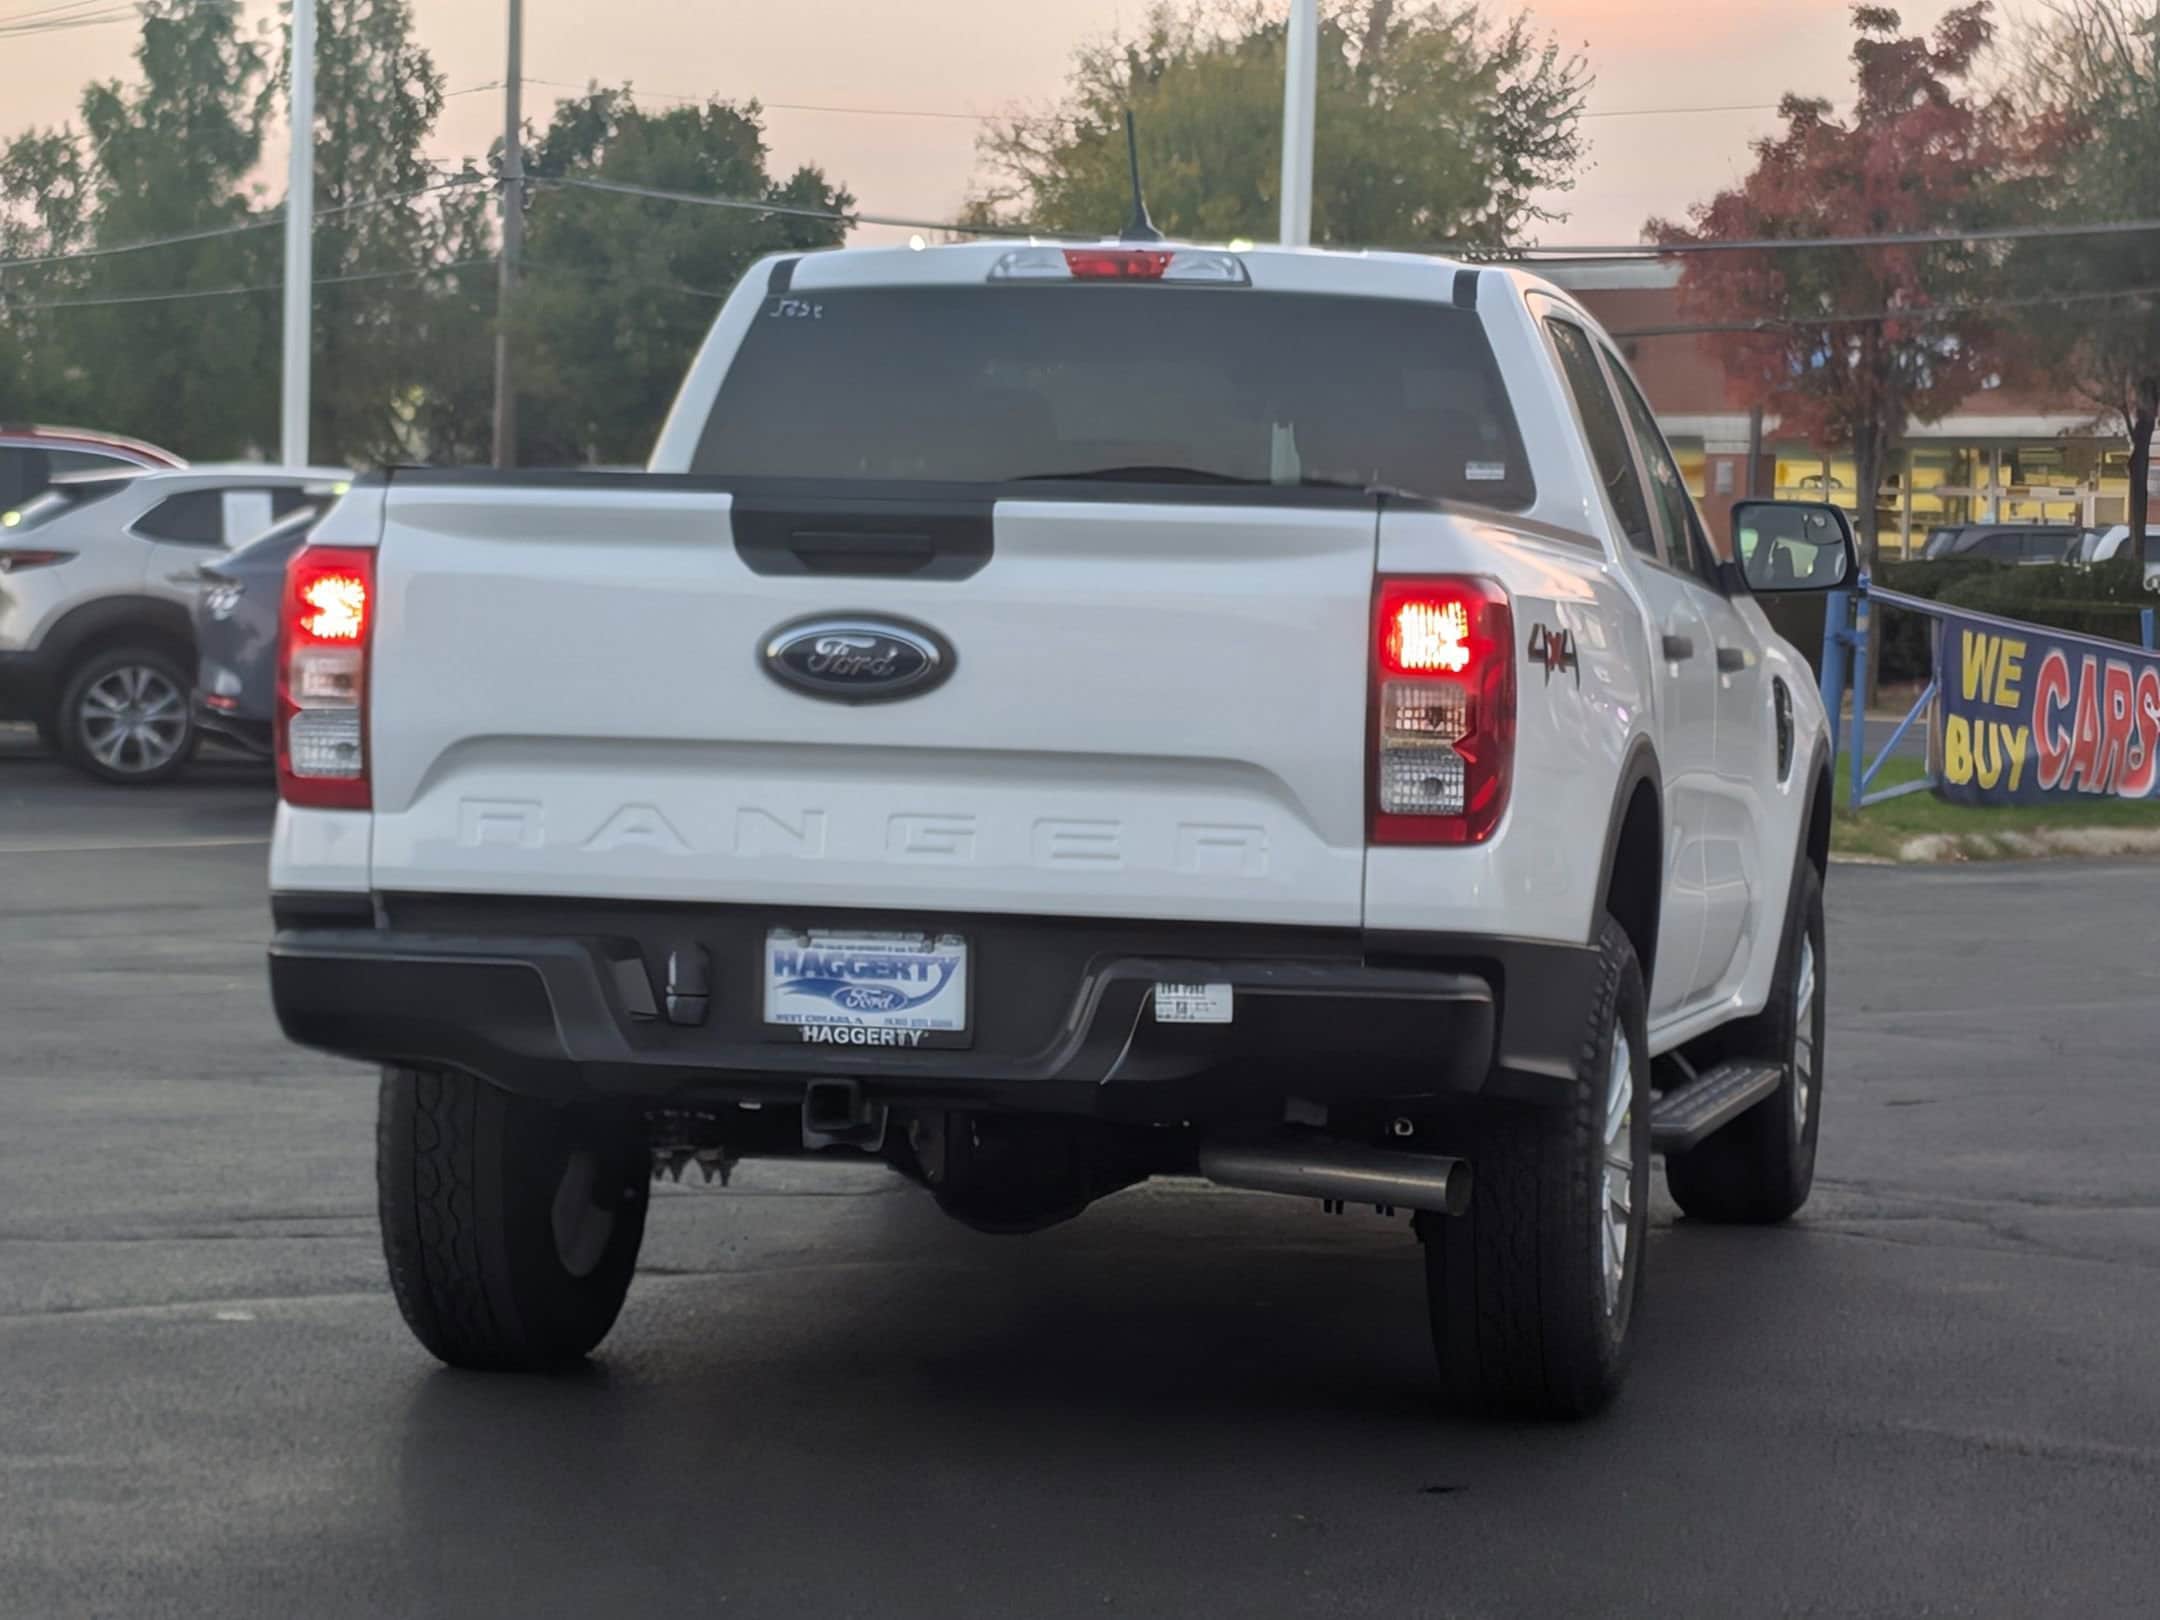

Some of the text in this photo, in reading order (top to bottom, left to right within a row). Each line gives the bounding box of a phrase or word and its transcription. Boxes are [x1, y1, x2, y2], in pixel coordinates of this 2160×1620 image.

[808, 637, 898, 676] Ford
[1963, 629, 2026, 708] WE
[2033, 648, 2160, 797] CARS
[1945, 713, 2029, 791] BUY
[457, 798, 1273, 876] RANGER
[774, 950, 960, 983] HAGGERTY
[846, 987, 894, 1009] Ford
[801, 1025, 923, 1046] HAGGERTY
